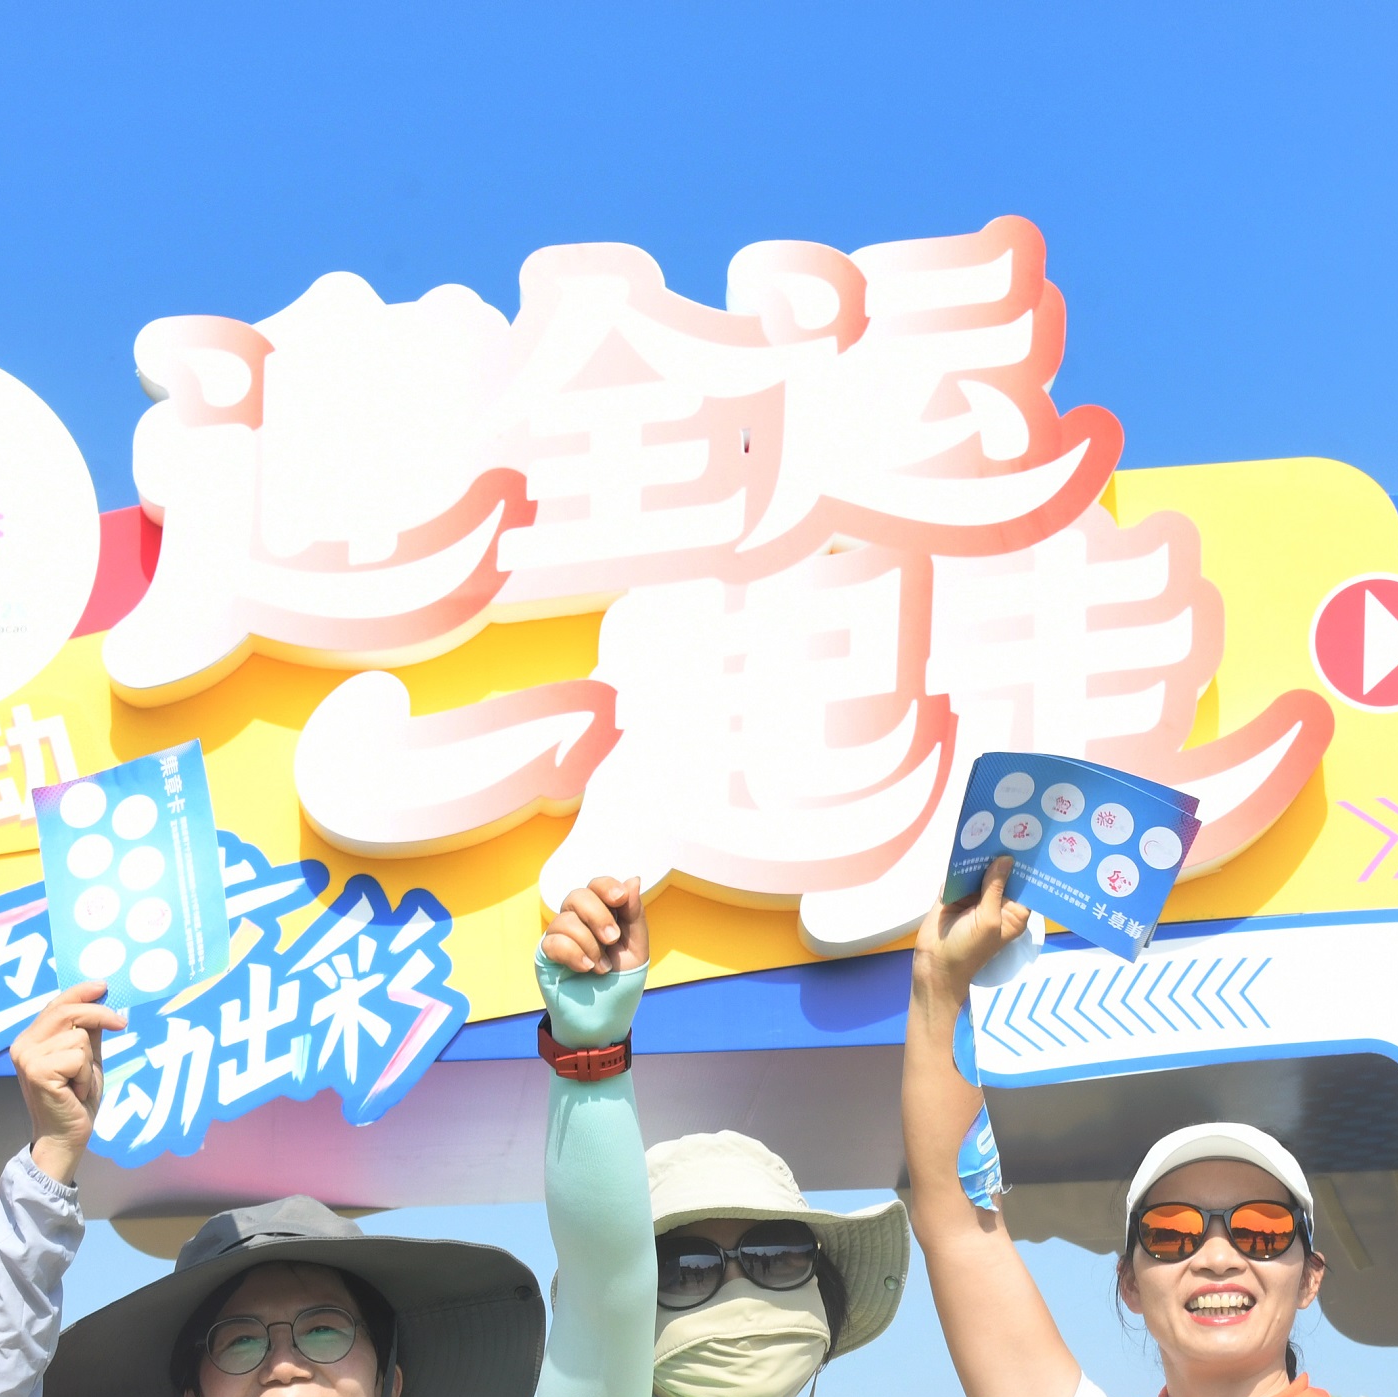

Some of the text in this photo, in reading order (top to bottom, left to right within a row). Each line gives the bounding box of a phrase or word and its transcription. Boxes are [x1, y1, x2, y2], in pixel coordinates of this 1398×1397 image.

[104, 215, 1123, 708] 迎全运
[158, 755, 187, 815] 集章卡
[295, 505, 1333, 957] 一起走
[1092, 901, 1145, 940] 集章卡
